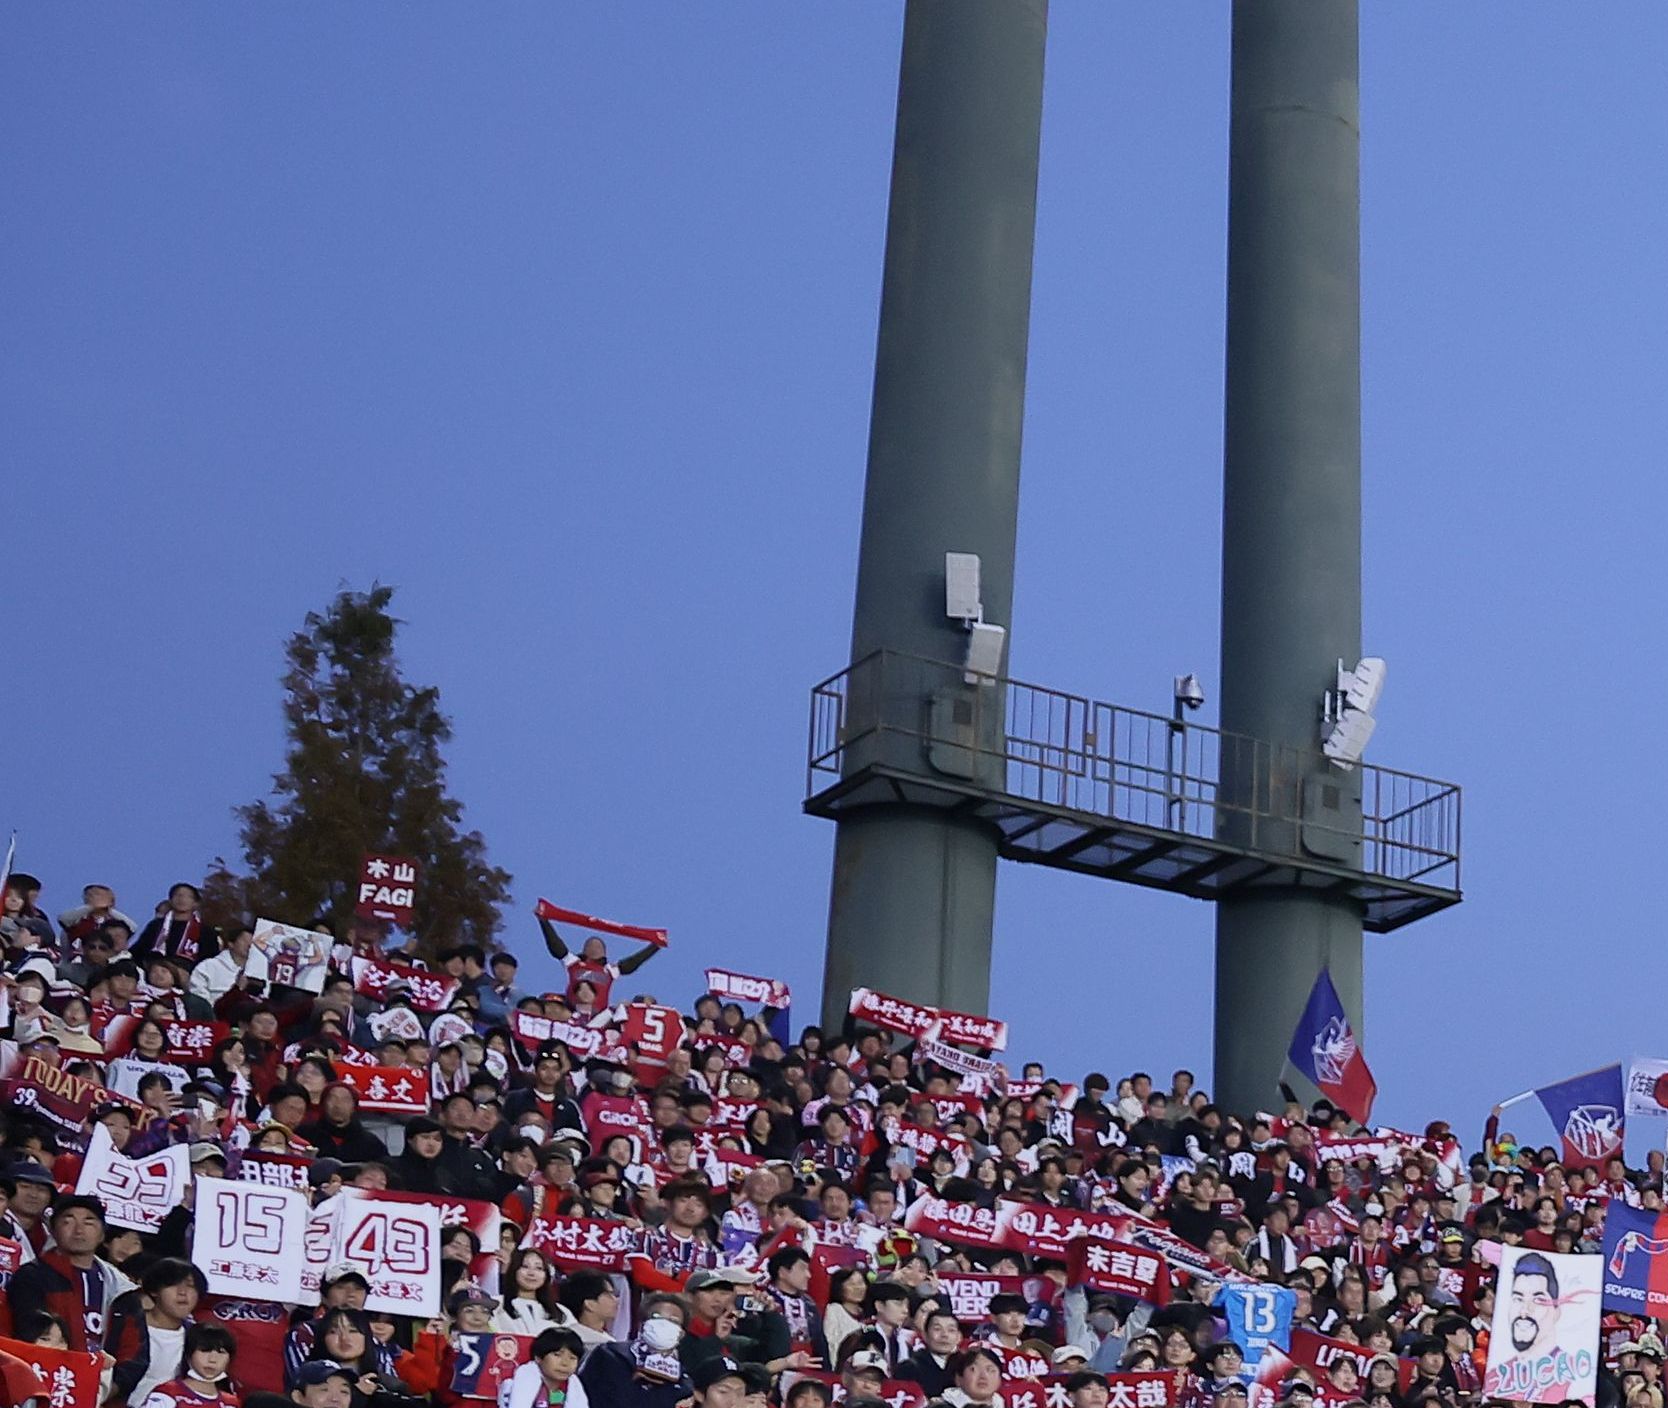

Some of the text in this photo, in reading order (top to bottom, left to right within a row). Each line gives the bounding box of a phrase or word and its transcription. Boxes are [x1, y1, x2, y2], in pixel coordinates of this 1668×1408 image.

[366, 858, 416, 883] 木山
[359, 883, 415, 908] FAGI
[275, 963, 296, 985] 19
[642, 1009, 667, 1043] 5
[13, 1087, 37, 1105] 39
[97, 1156, 174, 1207] 59
[217, 1192, 287, 1254] 15
[345, 1212, 430, 1275] 43
[1604, 1281, 1647, 1301] SEMPRE
[1243, 1292, 1277, 1334] 13
[459, 1334, 481, 1377] 5
